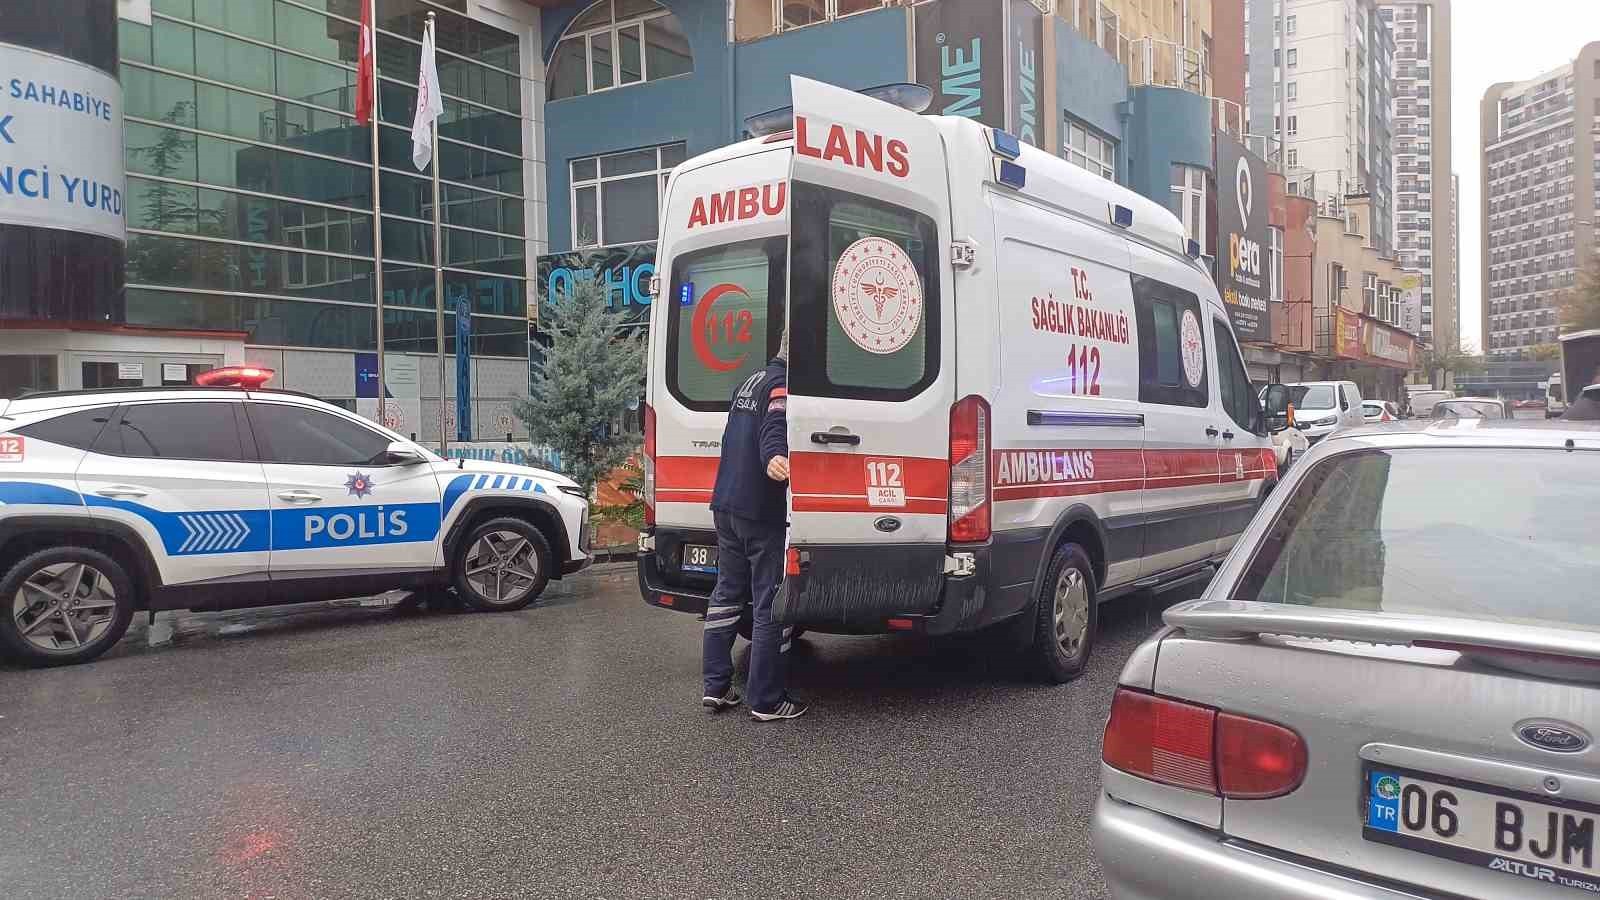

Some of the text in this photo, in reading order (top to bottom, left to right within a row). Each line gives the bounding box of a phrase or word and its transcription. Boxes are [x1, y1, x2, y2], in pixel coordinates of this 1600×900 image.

[10, 78, 112, 121] SAHABİYE
[796, 115, 910, 178] LANS
[688, 182, 786, 228] AMBU
[1230, 232, 1260, 278] pera
[1071, 267, 1092, 301] T.C.
[708, 309, 752, 347] 112
[1031, 290, 1129, 344] SAĞLIK BAKANLIĞI
[1068, 343, 1100, 395] 112
[867, 461, 902, 486] 112
[997, 451, 1095, 484] AMBULANS
[304, 505, 409, 542] POLİS
[691, 548, 707, 564] 38
[1375, 803, 1396, 821] TR
[1402, 783, 1595, 869] 06 BJM
[1488, 857, 1556, 882] ALTUR
